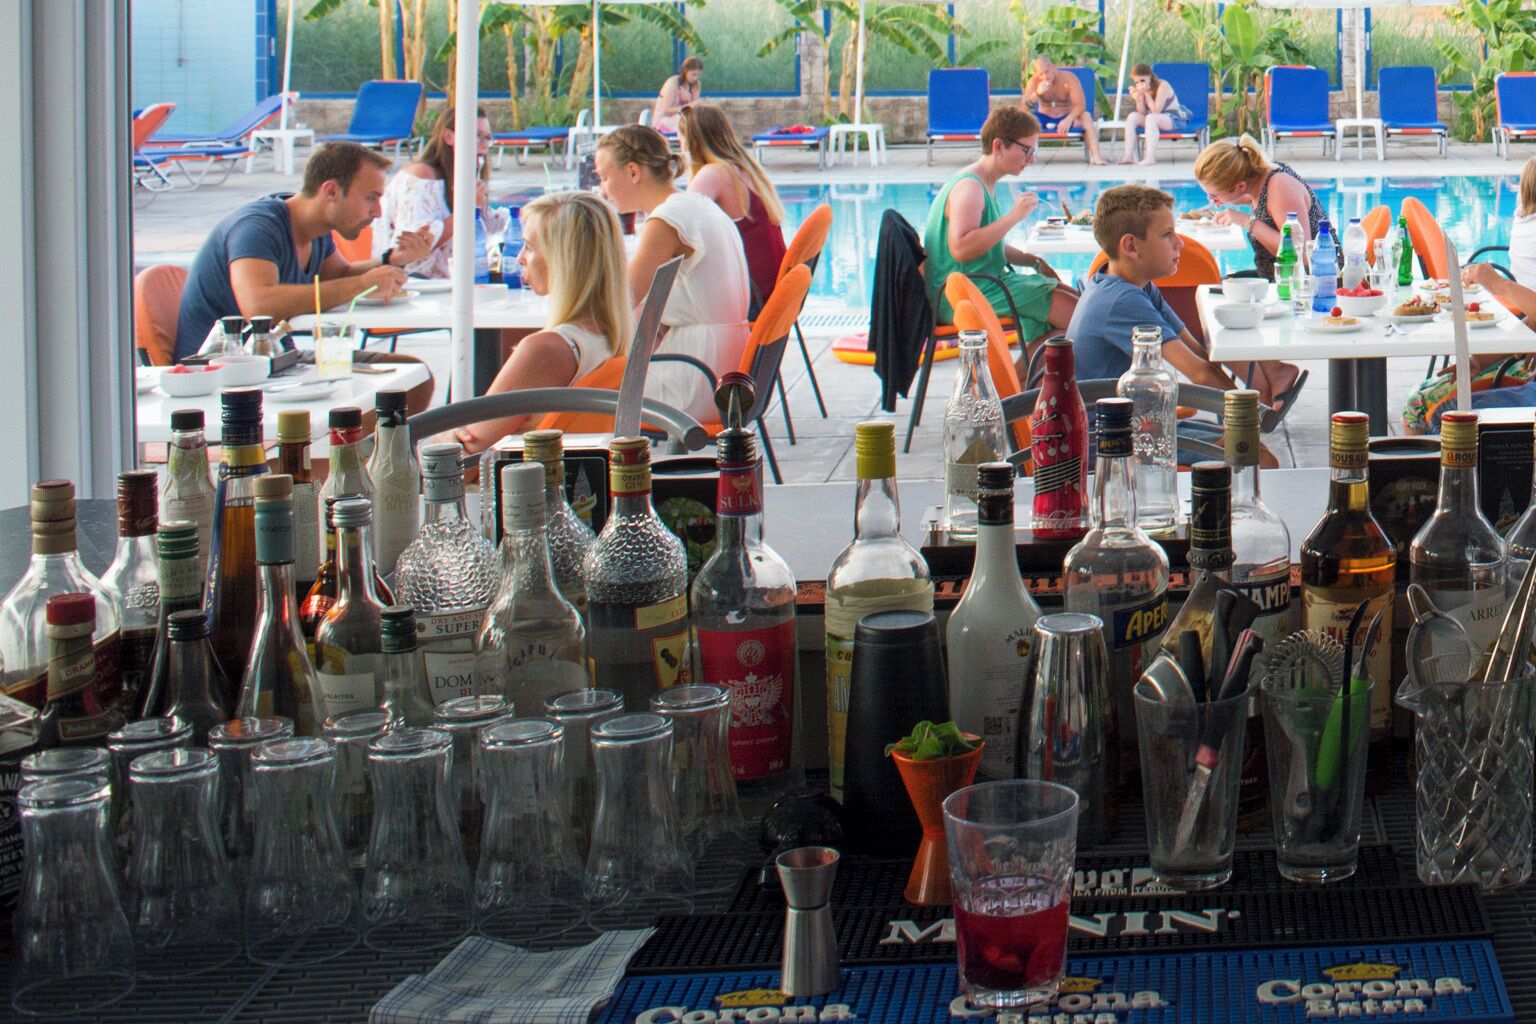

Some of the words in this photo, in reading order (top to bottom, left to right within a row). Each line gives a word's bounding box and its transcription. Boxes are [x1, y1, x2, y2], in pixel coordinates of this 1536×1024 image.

[880, 911, 1227, 945] MNIN
[949, 990, 1169, 1019] Cona
[1257, 976, 1474, 1006] Corona
[635, 1003, 859, 1024] Corona
[1304, 996, 1427, 1020] Extra
